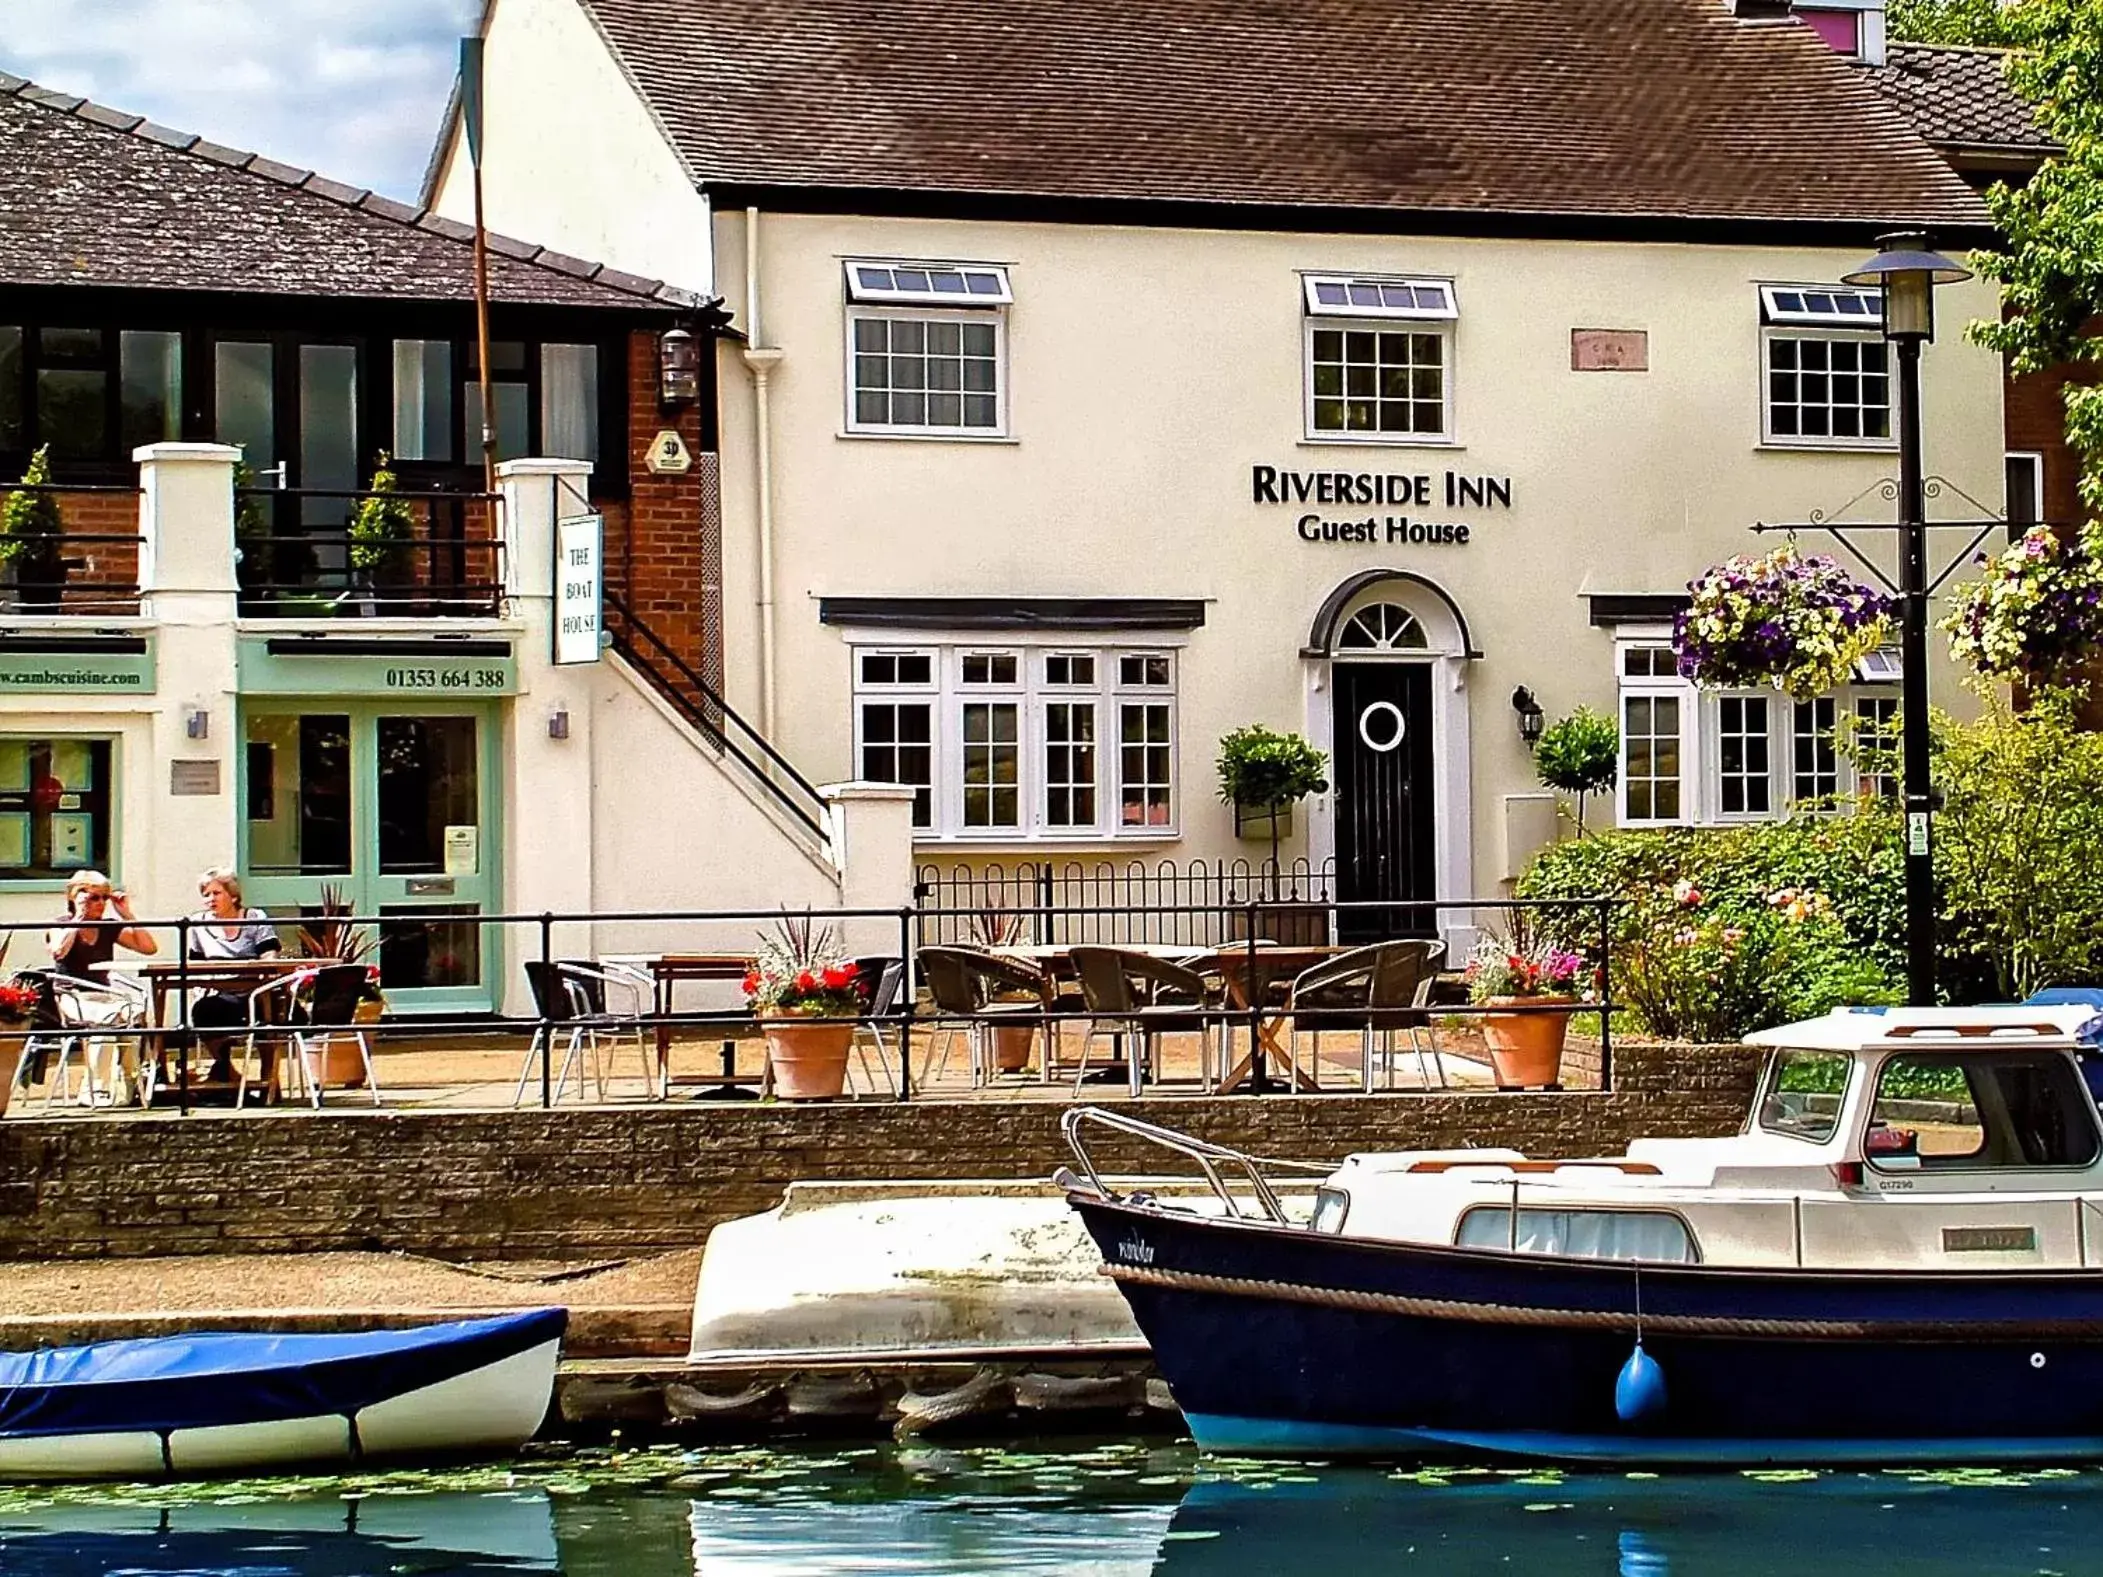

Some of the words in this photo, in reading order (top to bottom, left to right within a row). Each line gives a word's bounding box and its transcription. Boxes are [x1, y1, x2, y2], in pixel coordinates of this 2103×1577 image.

[1252, 465, 1430, 506] RIVERSIDE
[1446, 471, 1512, 508] INN
[1298, 514, 1377, 542] Guest
[1385, 516, 1470, 544] House
[570, 548, 590, 566] THE
[566, 581, 592, 600] BOAT
[563, 615, 596, 634] HOUSE
[386, 668, 436, 687] 01353
[441, 669, 470, 687] 664
[475, 669, 505, 688] 388
